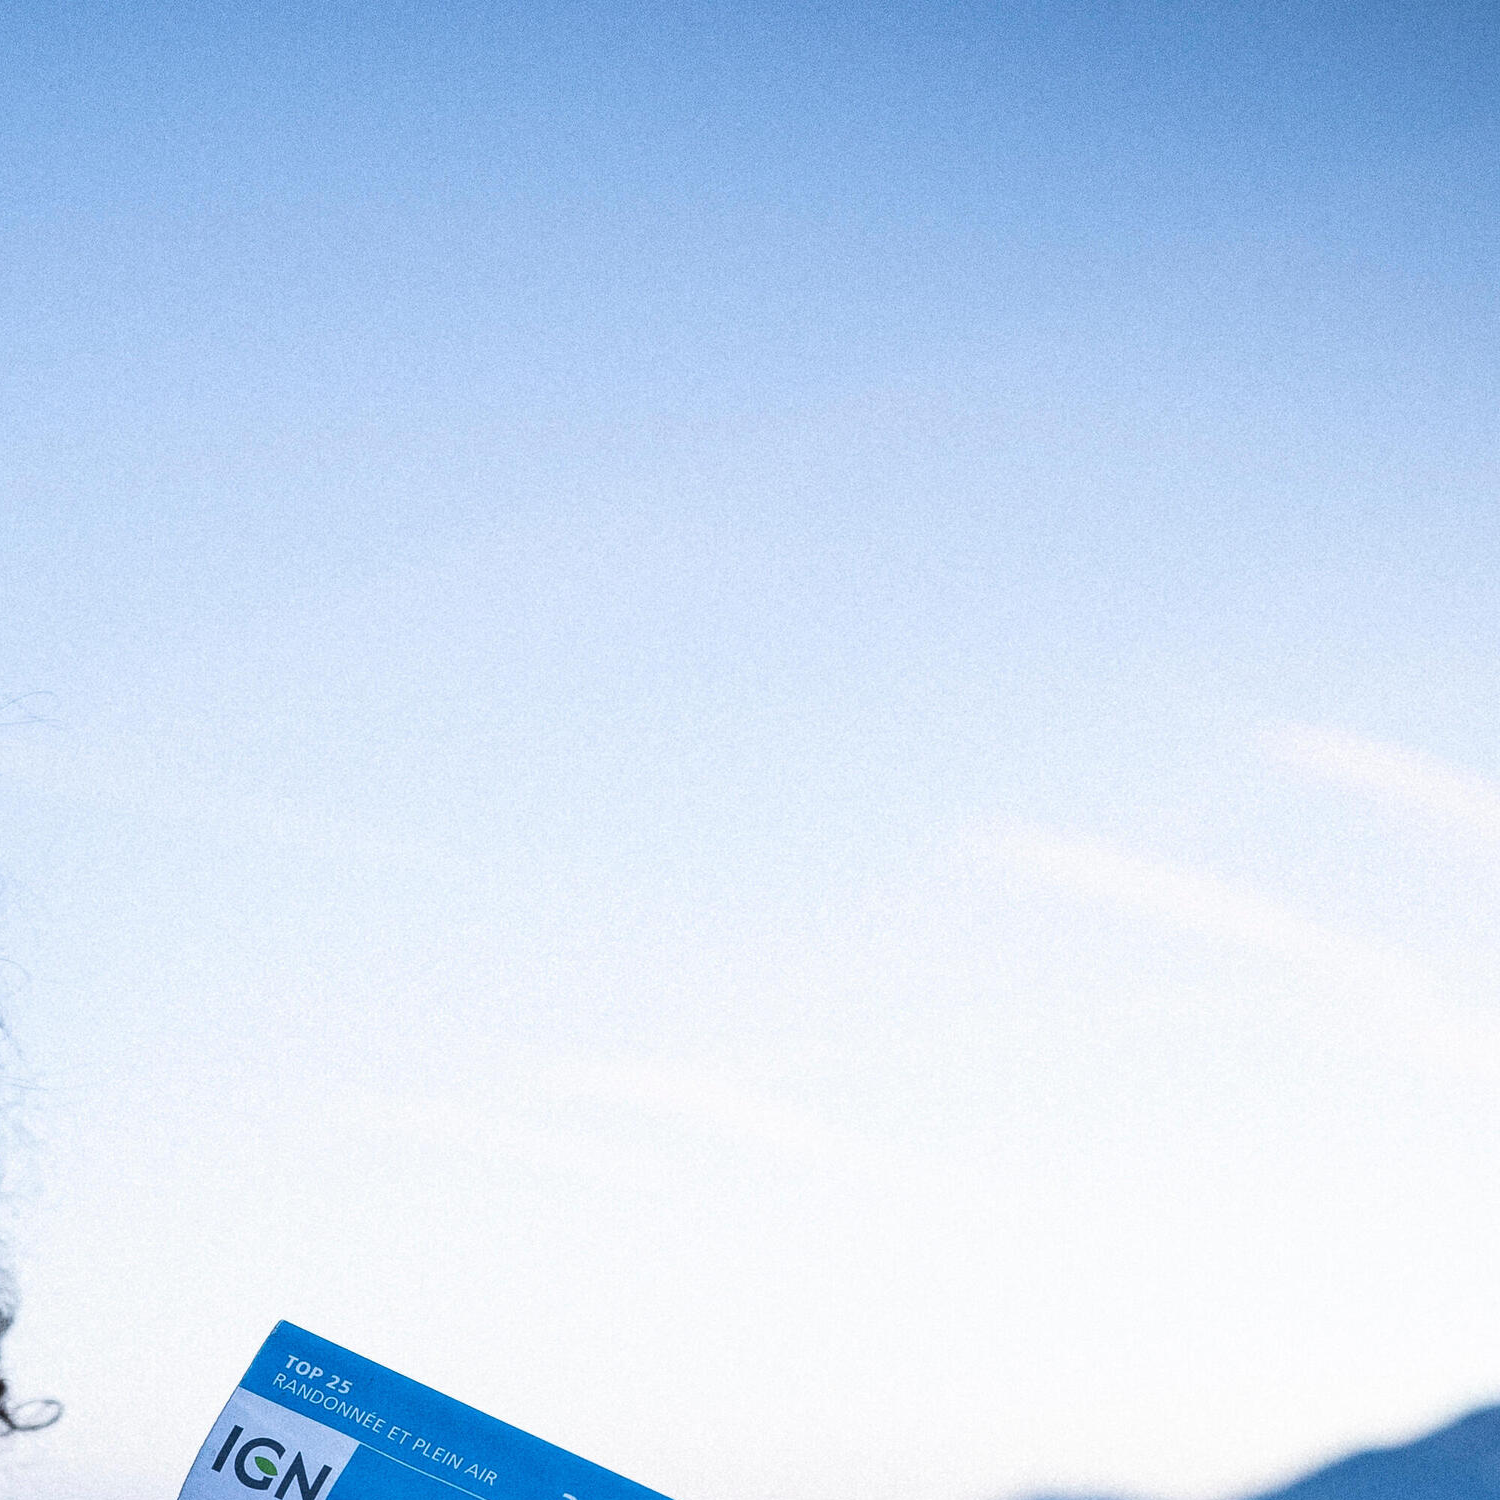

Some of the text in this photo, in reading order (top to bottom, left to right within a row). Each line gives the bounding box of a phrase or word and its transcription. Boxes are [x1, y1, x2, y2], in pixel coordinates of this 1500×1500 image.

[284, 1354, 353, 1394] TOP 25
[272, 1372, 499, 1487] RANDONNÉE ET PLEIN AIR
